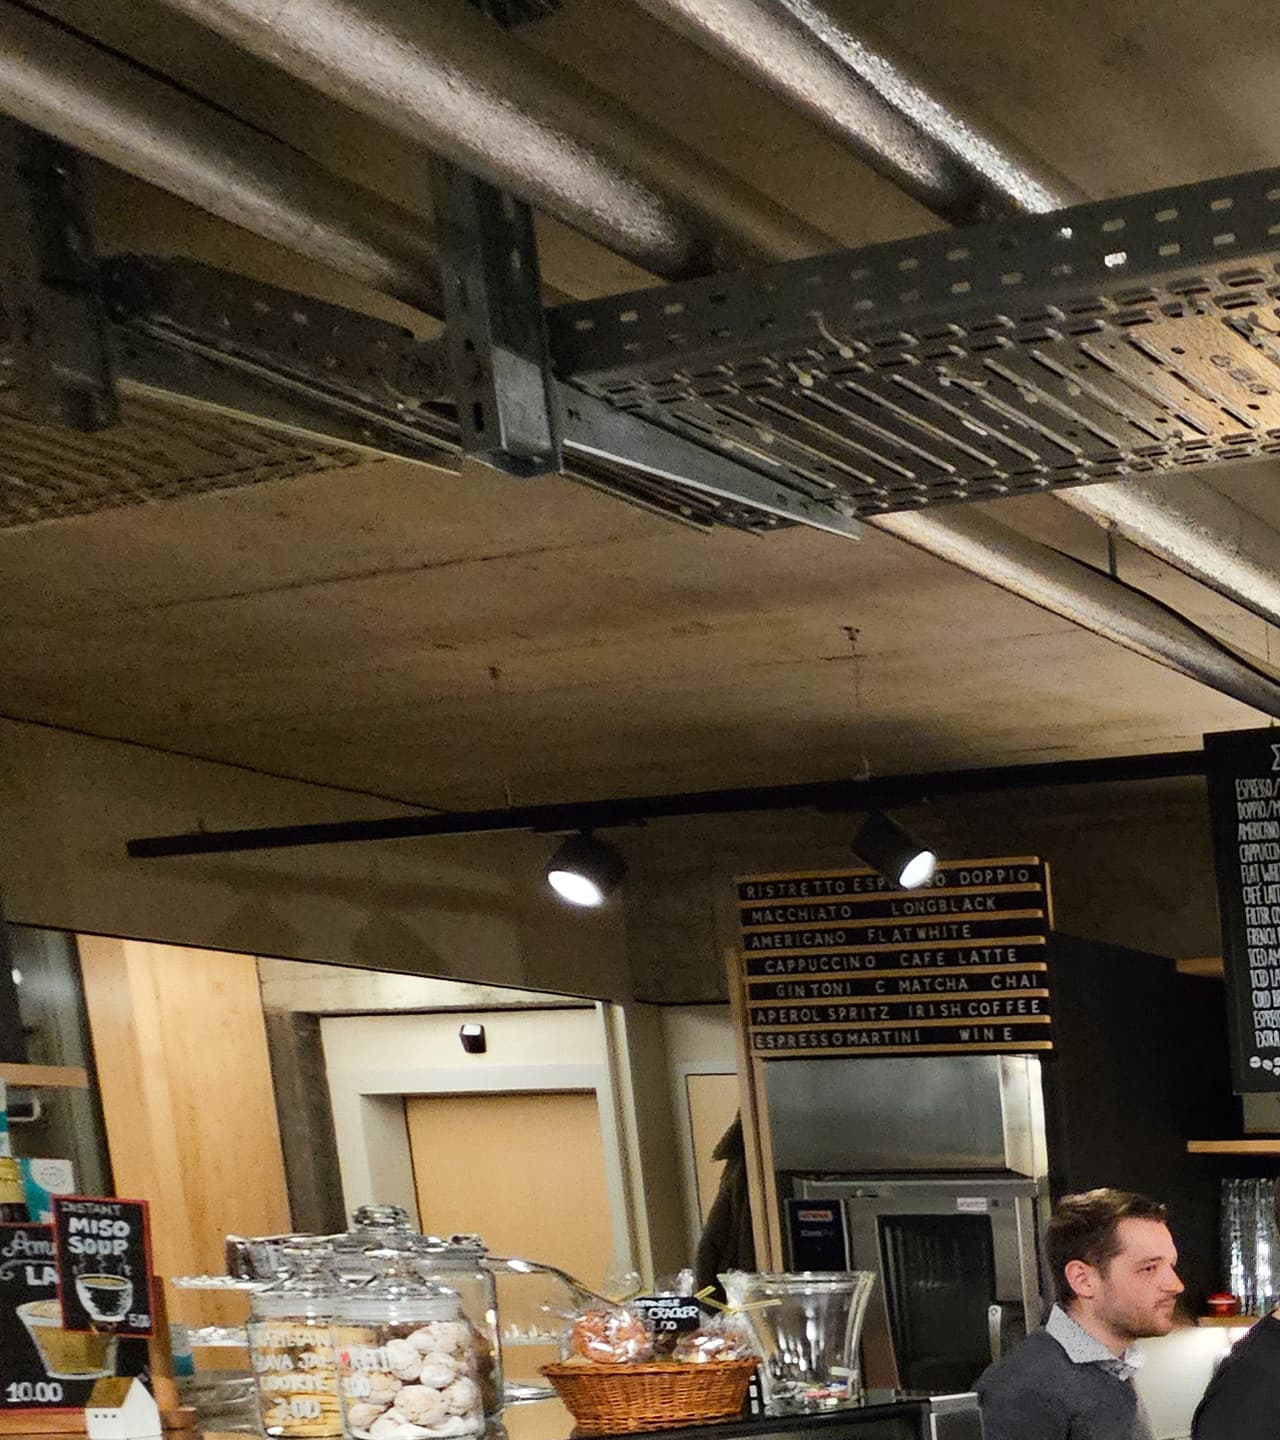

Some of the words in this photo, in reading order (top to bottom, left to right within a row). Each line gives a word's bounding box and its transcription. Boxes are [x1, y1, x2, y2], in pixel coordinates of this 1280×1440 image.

[1240, 863, 1260, 884] FLAT
[746, 879, 845, 900] RISTRETTO
[853, 868, 946, 893] ESPSO
[959, 868, 1031, 886] DOPPIO
[751, 904, 852, 925] MACCHIATO
[1245, 906, 1270, 926] FILTER
[751, 930, 846, 949] AMERICANO
[1247, 926, 1277, 946] FRENCH
[764, 954, 877, 974] CAPPUCCINO
[900, 951, 945, 967] CAFE
[958, 949, 1018, 965] LATTE
[899, 977, 968, 994] MATCHA
[991, 974, 1038, 990] CHAI
[756, 1007, 821, 1024] APEROL
[828, 1004, 890, 1021] SPRITZ
[958, 1026, 1015, 1043] WINE
[1255, 1029, 1280, 1049] EXTRA
[68, 1217, 131, 1238] MISO
[67, 1235, 129, 1256] SOUP
[5, 1381, 63, 1402] 10.00
